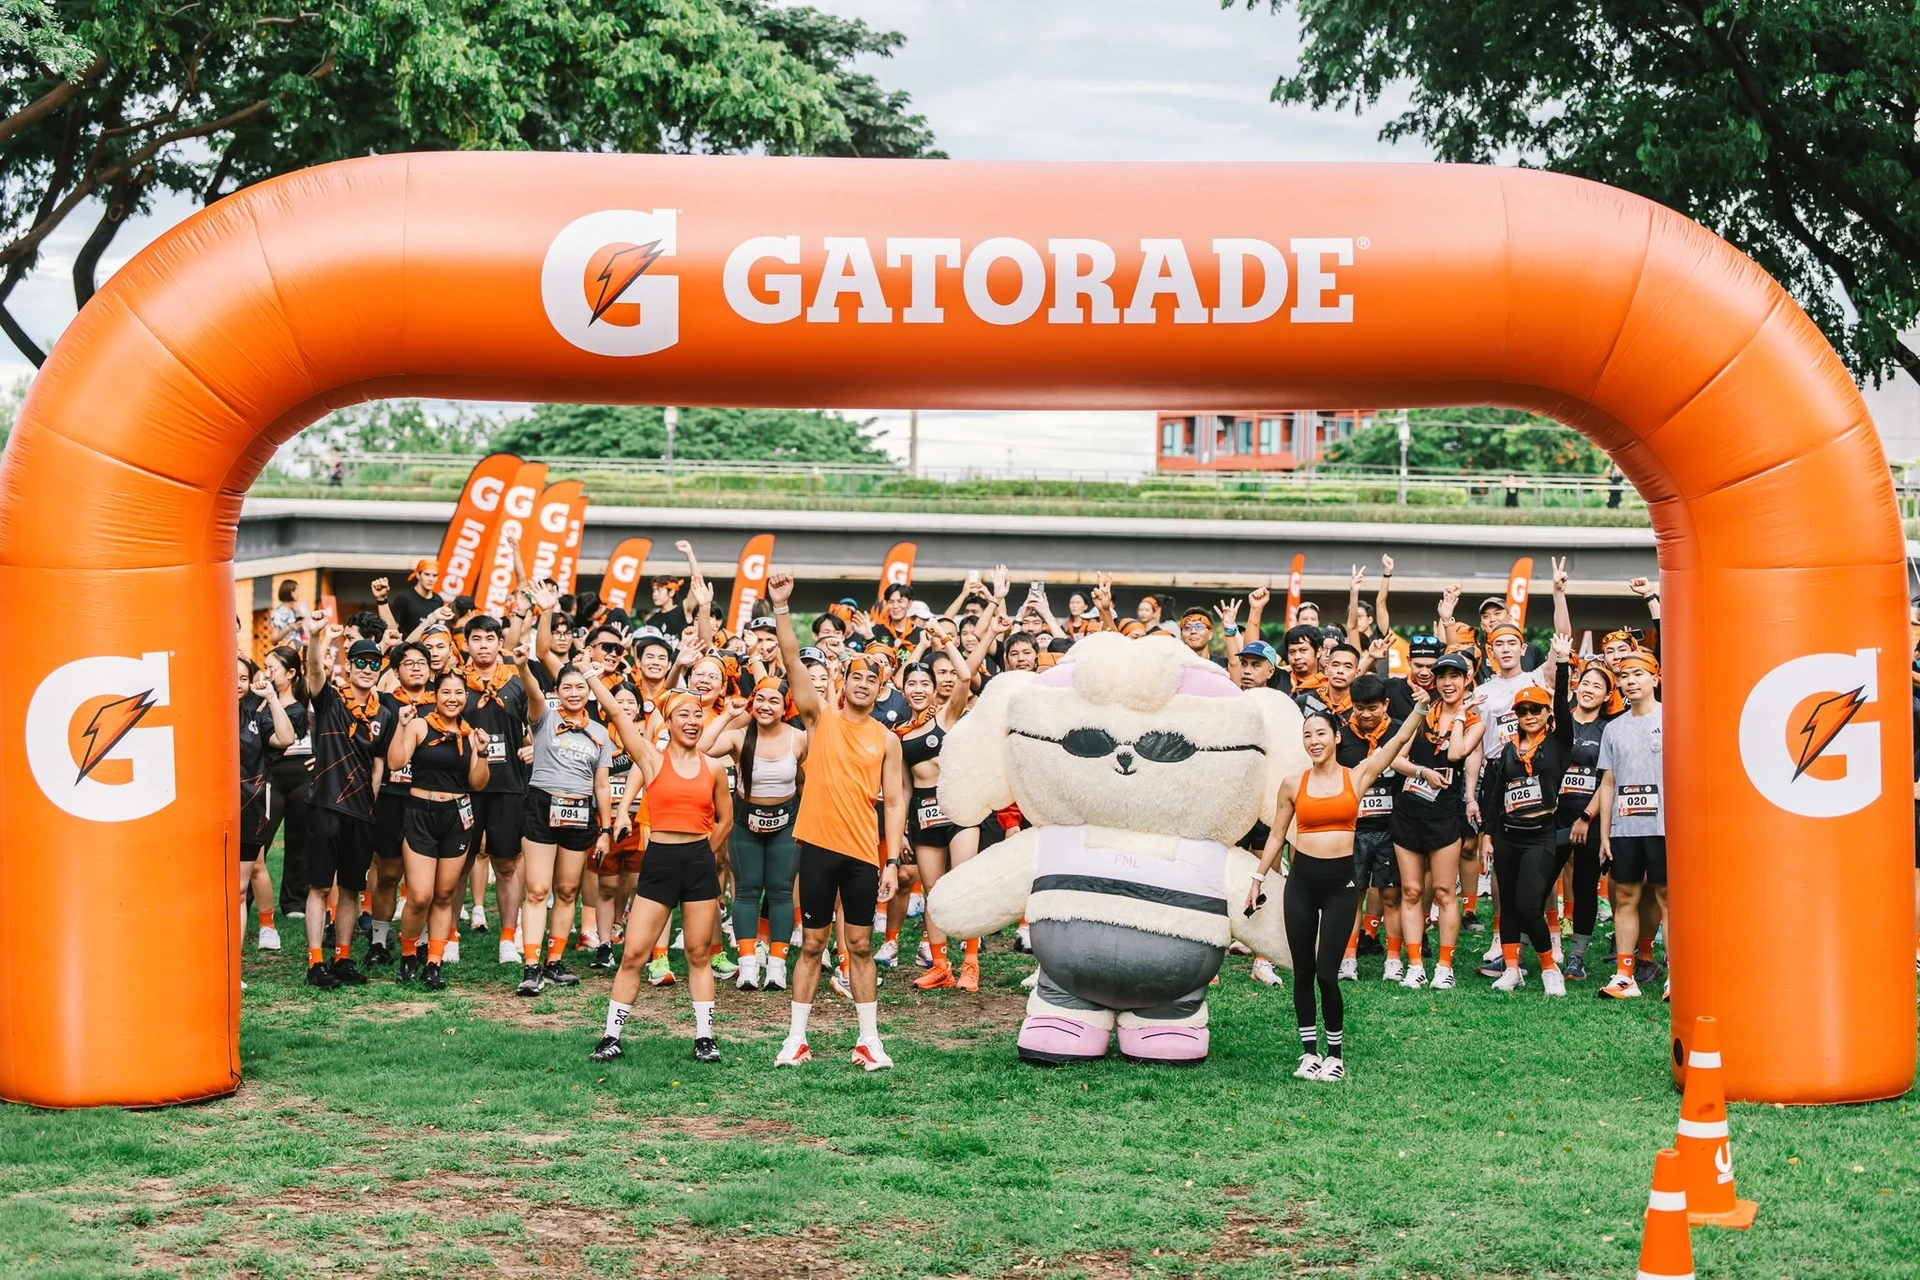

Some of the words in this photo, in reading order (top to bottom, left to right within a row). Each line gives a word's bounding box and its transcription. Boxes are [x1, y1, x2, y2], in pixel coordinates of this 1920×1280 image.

[541, 208, 680, 357] G
[723, 235, 1354, 325] GATORADE
[470, 476, 505, 512] G
[504, 485, 536, 518] G
[540, 502, 570, 533] G
[612, 555, 639, 583] G
[742, 554, 765, 580] G
[1511, 576, 1528, 603] G
[25, 651, 176, 823] G
[1738, 648, 1882, 818] G
[1565, 776, 1585, 786] 080
[1362, 798, 1382, 808] 102
[1511, 789, 1531, 801] 026
[1627, 796, 1647, 806] 020
[560, 809, 579, 818] 094
[758, 818, 780, 827] 089
[1114, 854, 1141, 869] FML
